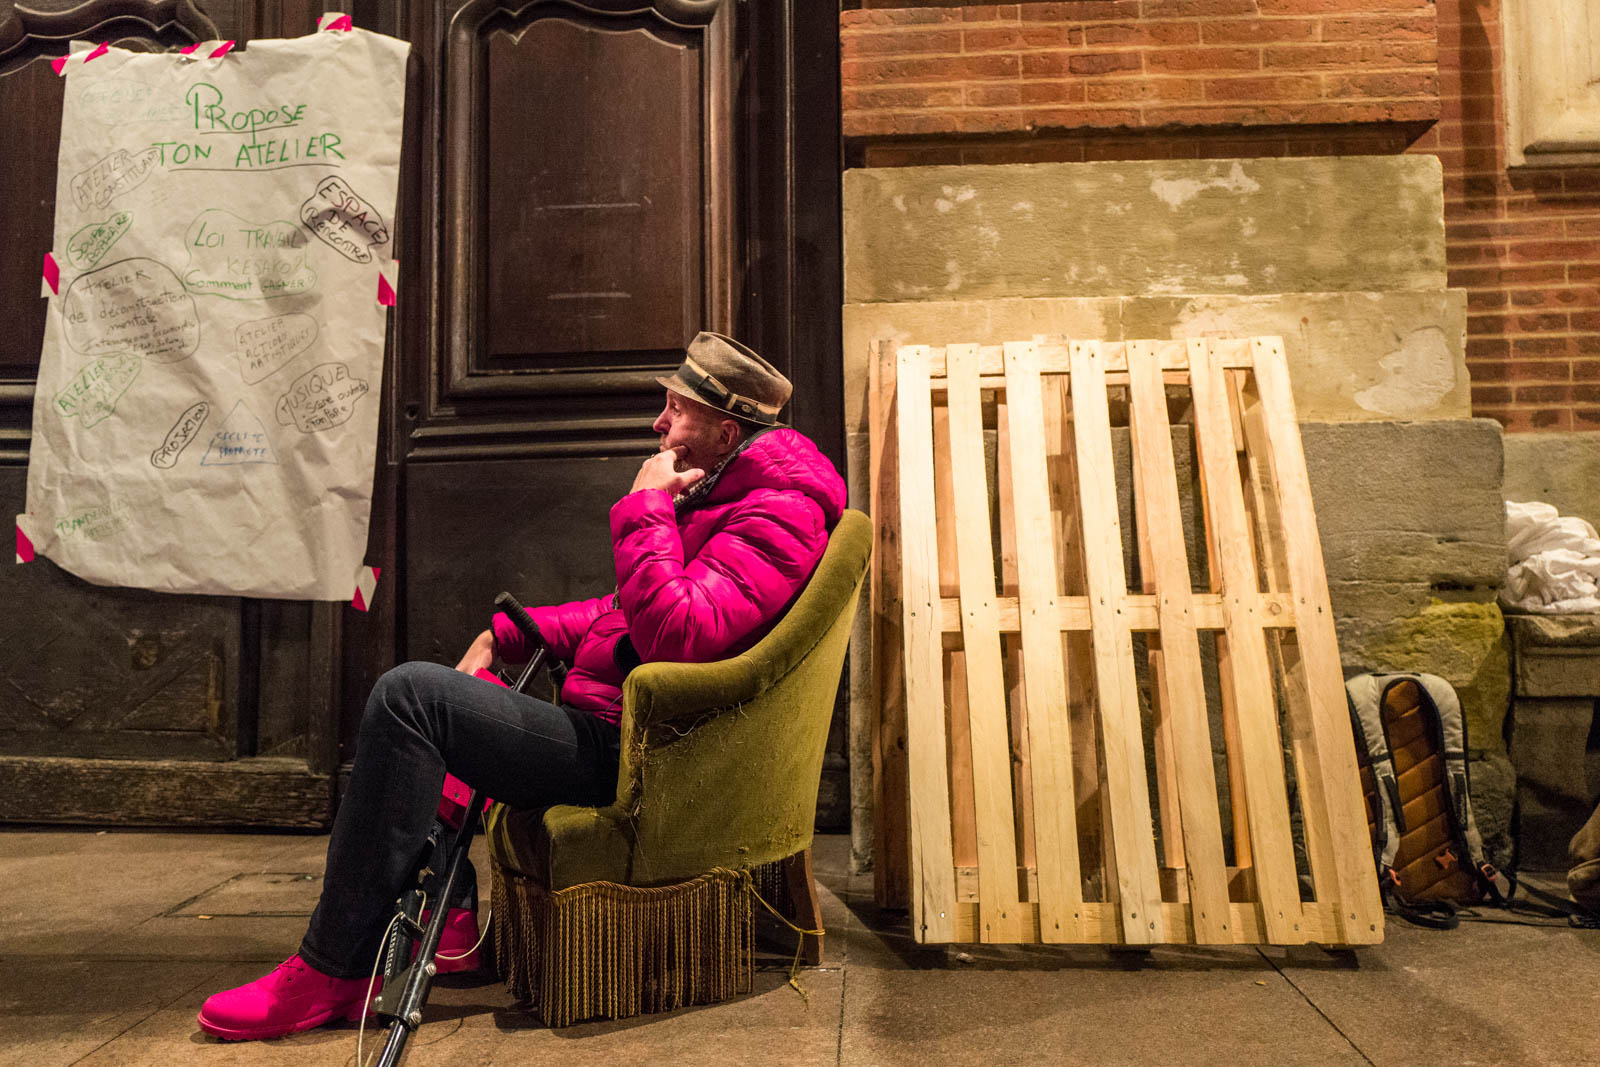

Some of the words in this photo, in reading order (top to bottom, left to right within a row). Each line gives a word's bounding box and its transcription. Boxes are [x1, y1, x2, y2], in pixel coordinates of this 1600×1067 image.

[152, 141, 211, 166] TON
[236, 133, 346, 167] ATELIER
[77, 151, 131, 204] ATELIER
[319, 182, 385, 243] ESPACE
[329, 209, 353, 232] DE
[194, 221, 225, 247] LOI
[239, 229, 303, 249] TRAVAIL
[69, 303, 88, 324] de
[58, 360, 105, 411] ATELIER
[155, 404, 205, 464] PROJECTION
